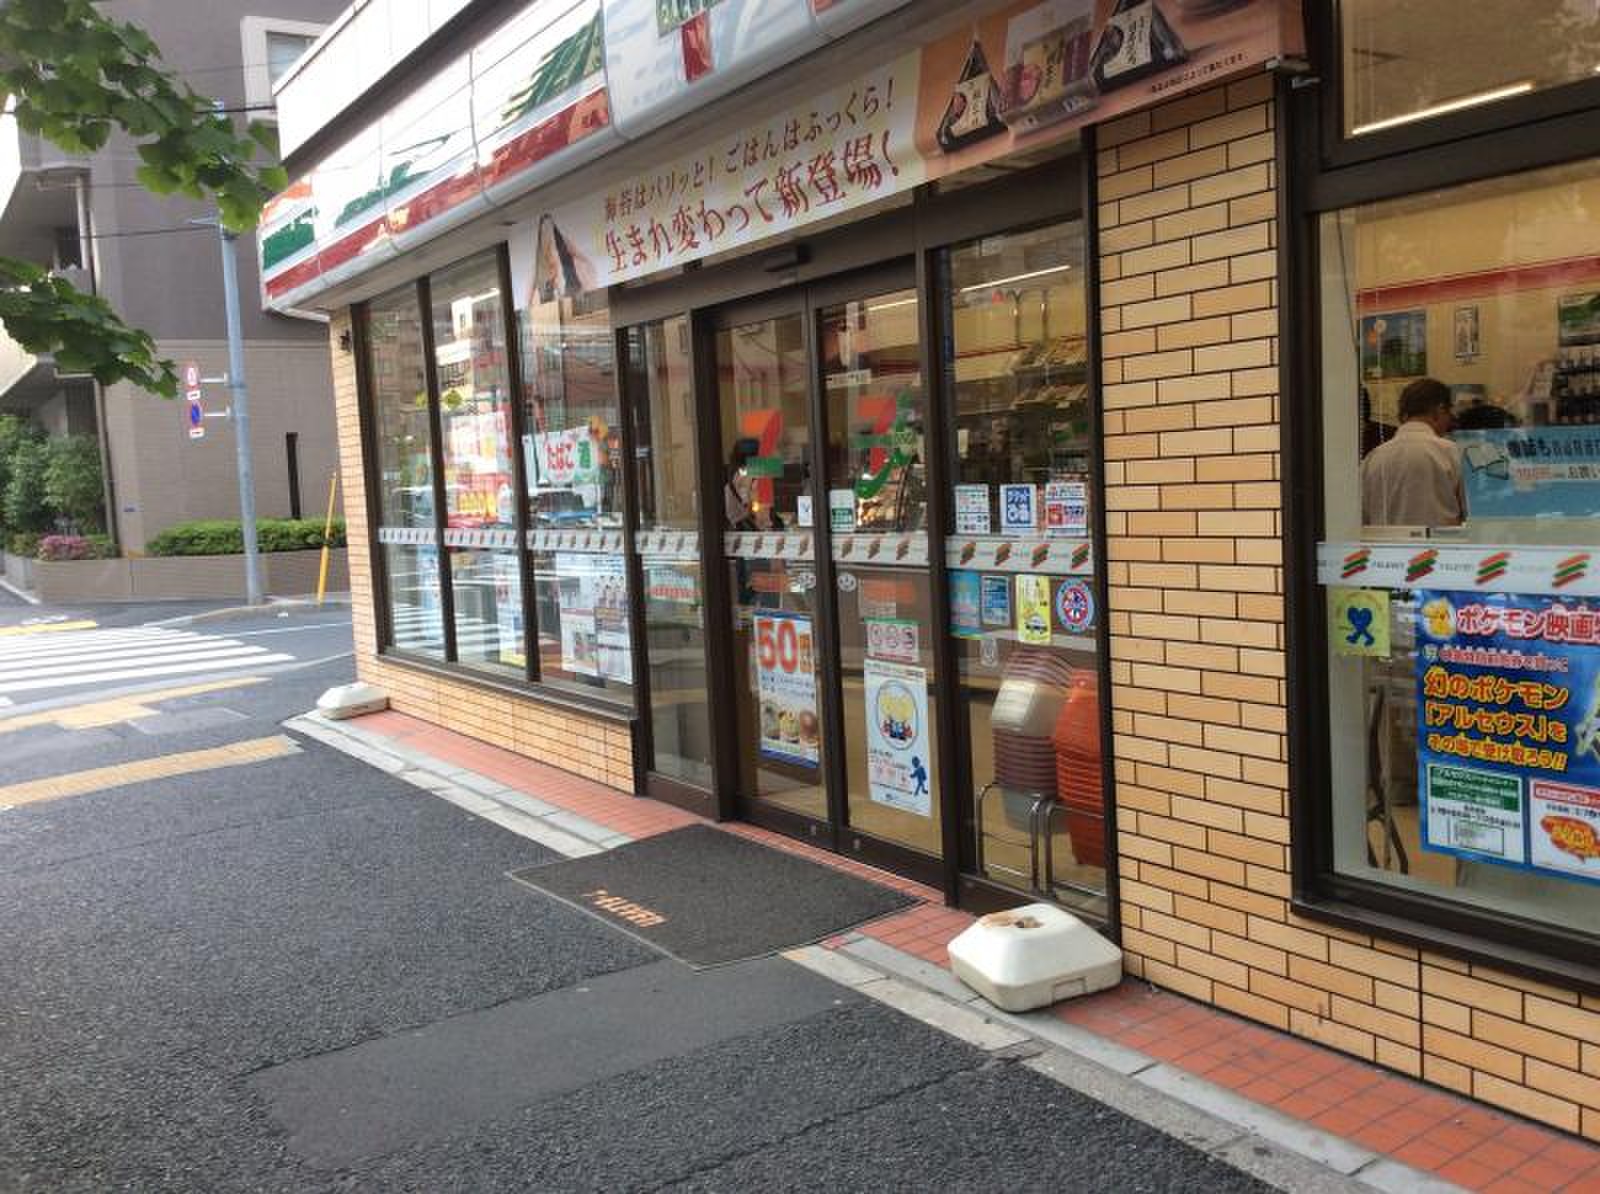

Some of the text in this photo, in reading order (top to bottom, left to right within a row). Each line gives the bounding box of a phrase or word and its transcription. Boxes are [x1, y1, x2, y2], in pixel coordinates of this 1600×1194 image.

[605, 131, 900, 272] 生まれ変わって新登場!
[756, 617, 799, 672] 50
[1456, 603, 1600, 645] ポケモン映画
[1424, 665, 1570, 711] 幻のポケモン
